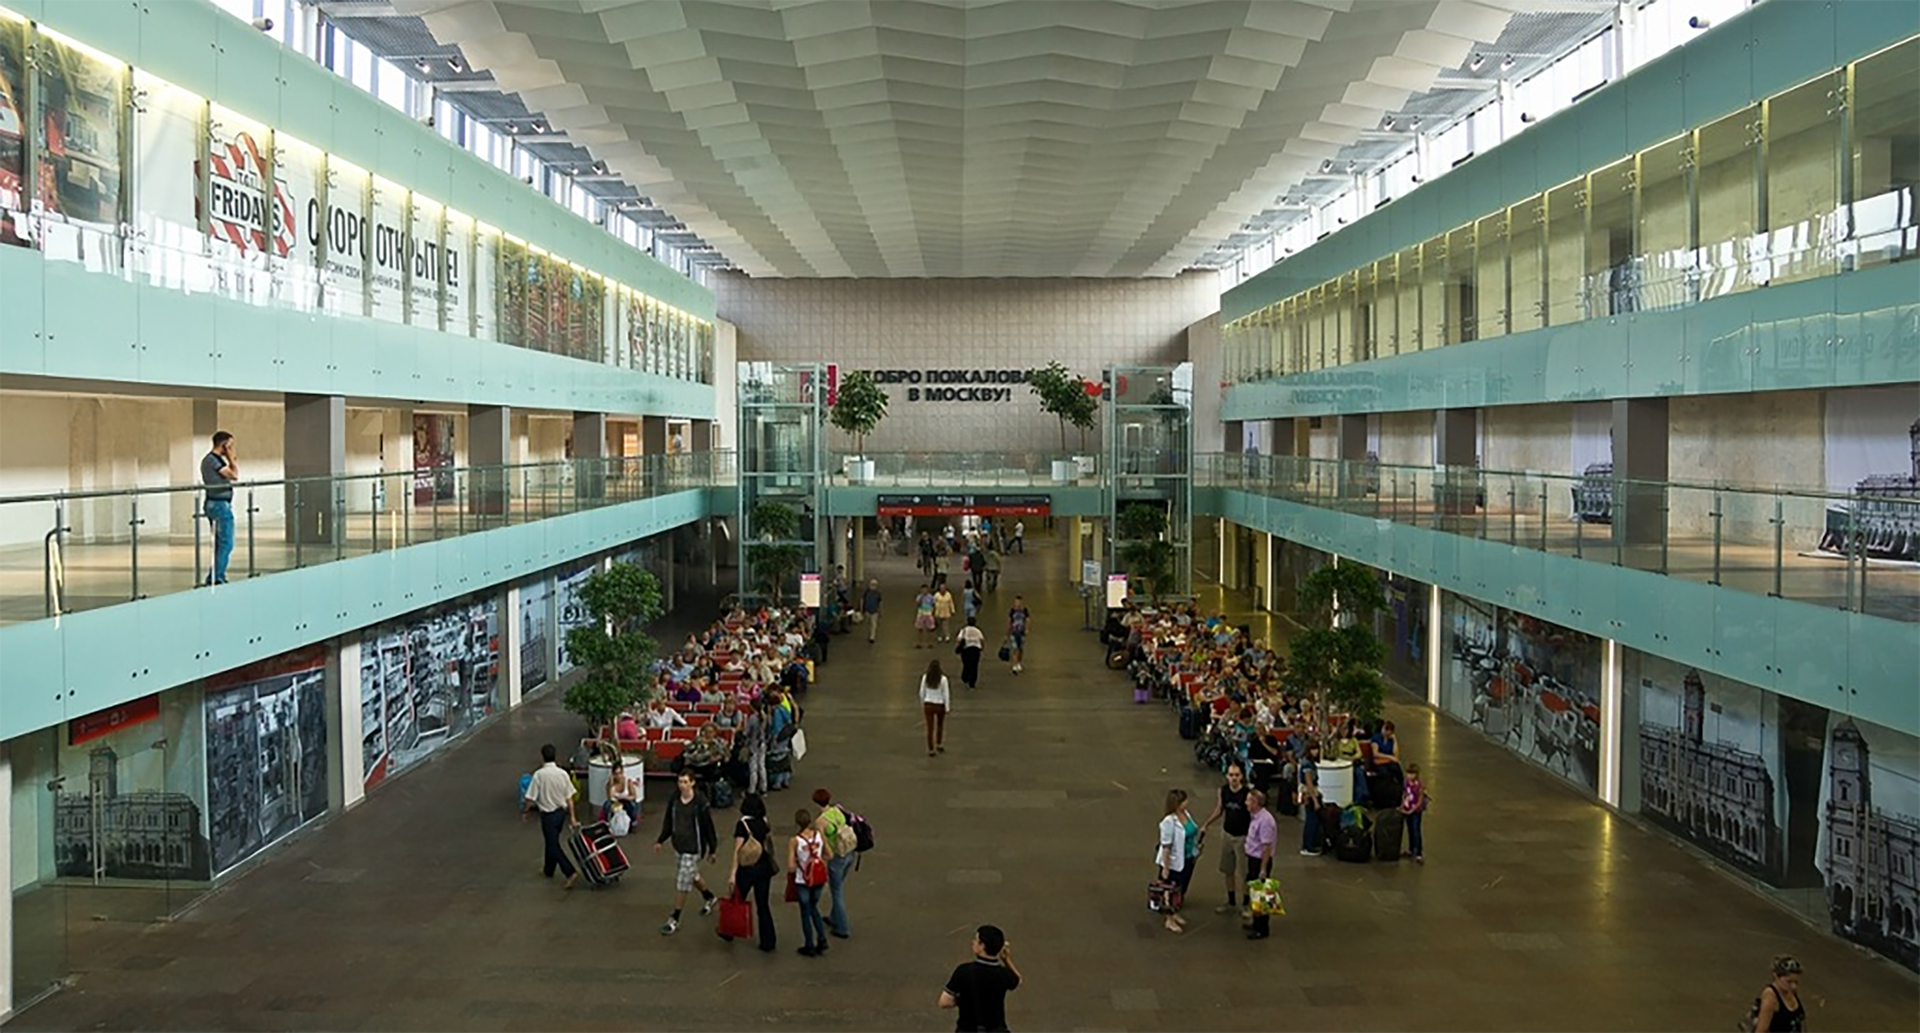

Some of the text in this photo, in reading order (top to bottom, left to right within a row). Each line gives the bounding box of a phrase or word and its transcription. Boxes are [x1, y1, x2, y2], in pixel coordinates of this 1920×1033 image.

[376, 223, 458, 287] ОТКРЫТЕ!
[862, 370, 921, 384] ОБРО
[908, 388, 1011, 402] В МОСКВУ!
